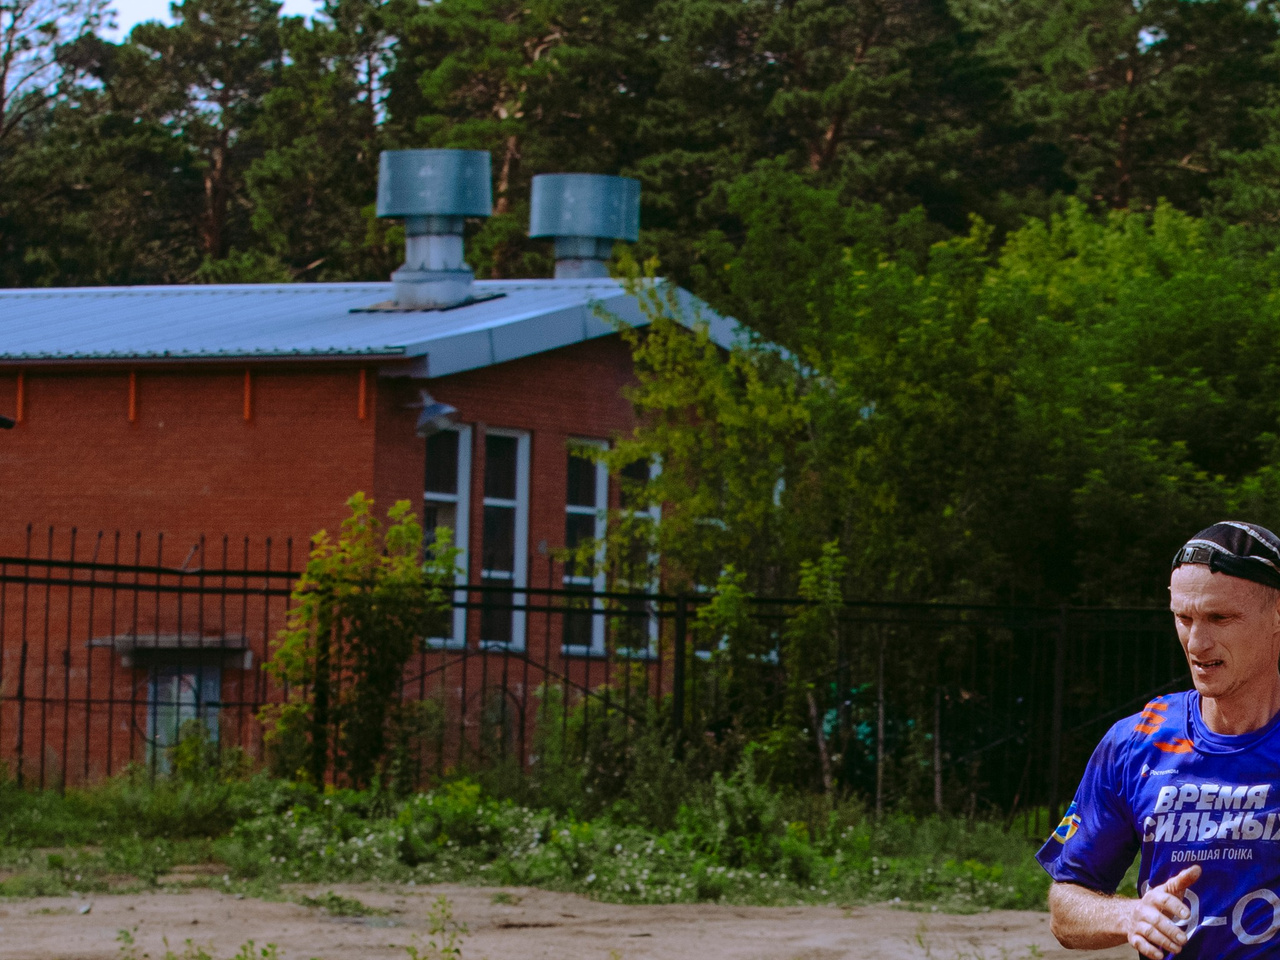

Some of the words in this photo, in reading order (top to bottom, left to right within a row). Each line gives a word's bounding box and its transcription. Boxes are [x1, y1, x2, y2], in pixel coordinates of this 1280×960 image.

[1154, 784, 1271, 813] ВРЕМЯ
[1171, 849, 1220, 862] БОЛЬШАЯ
[1222, 848, 1253, 860] ГОНКА
